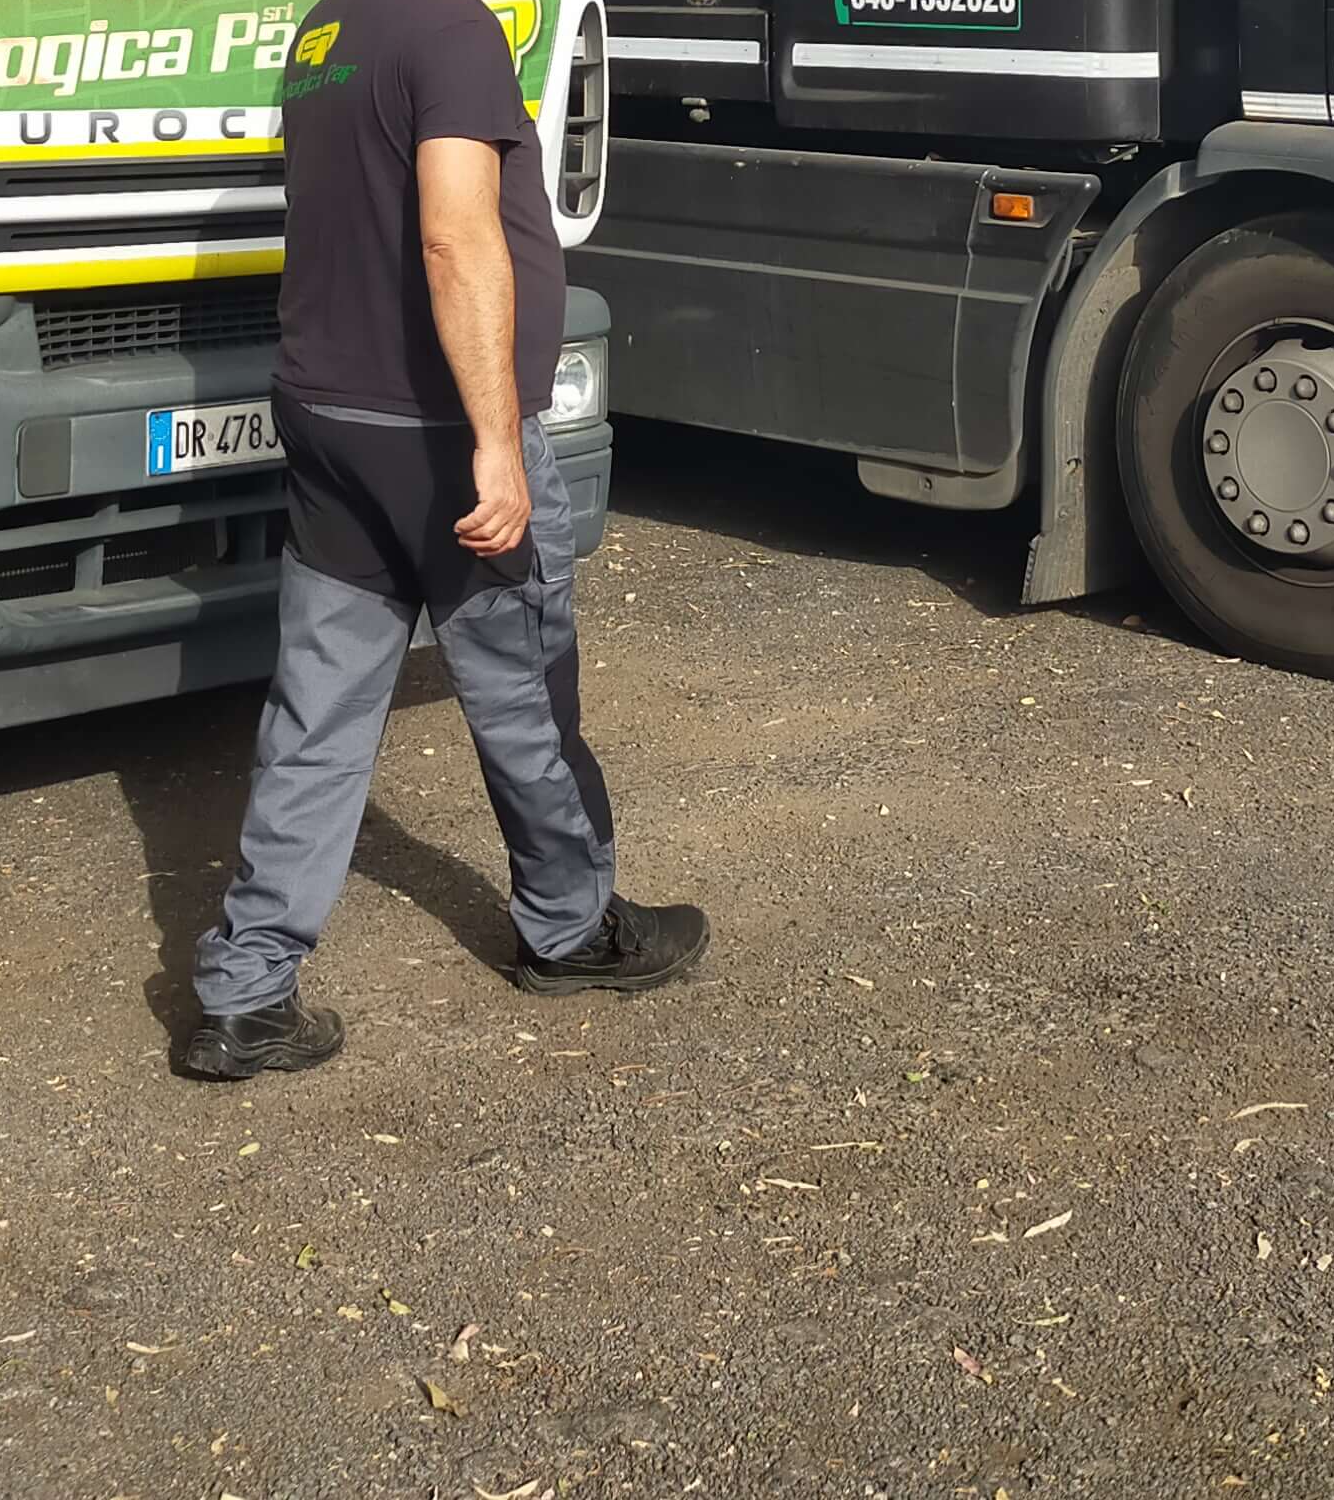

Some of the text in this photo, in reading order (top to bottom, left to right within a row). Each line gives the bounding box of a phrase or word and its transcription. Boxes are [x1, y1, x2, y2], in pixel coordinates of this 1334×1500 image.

[262, 2, 295, 22] srl
[210, 12, 299, 75] Pa
[175, 419, 206, 460] DR
